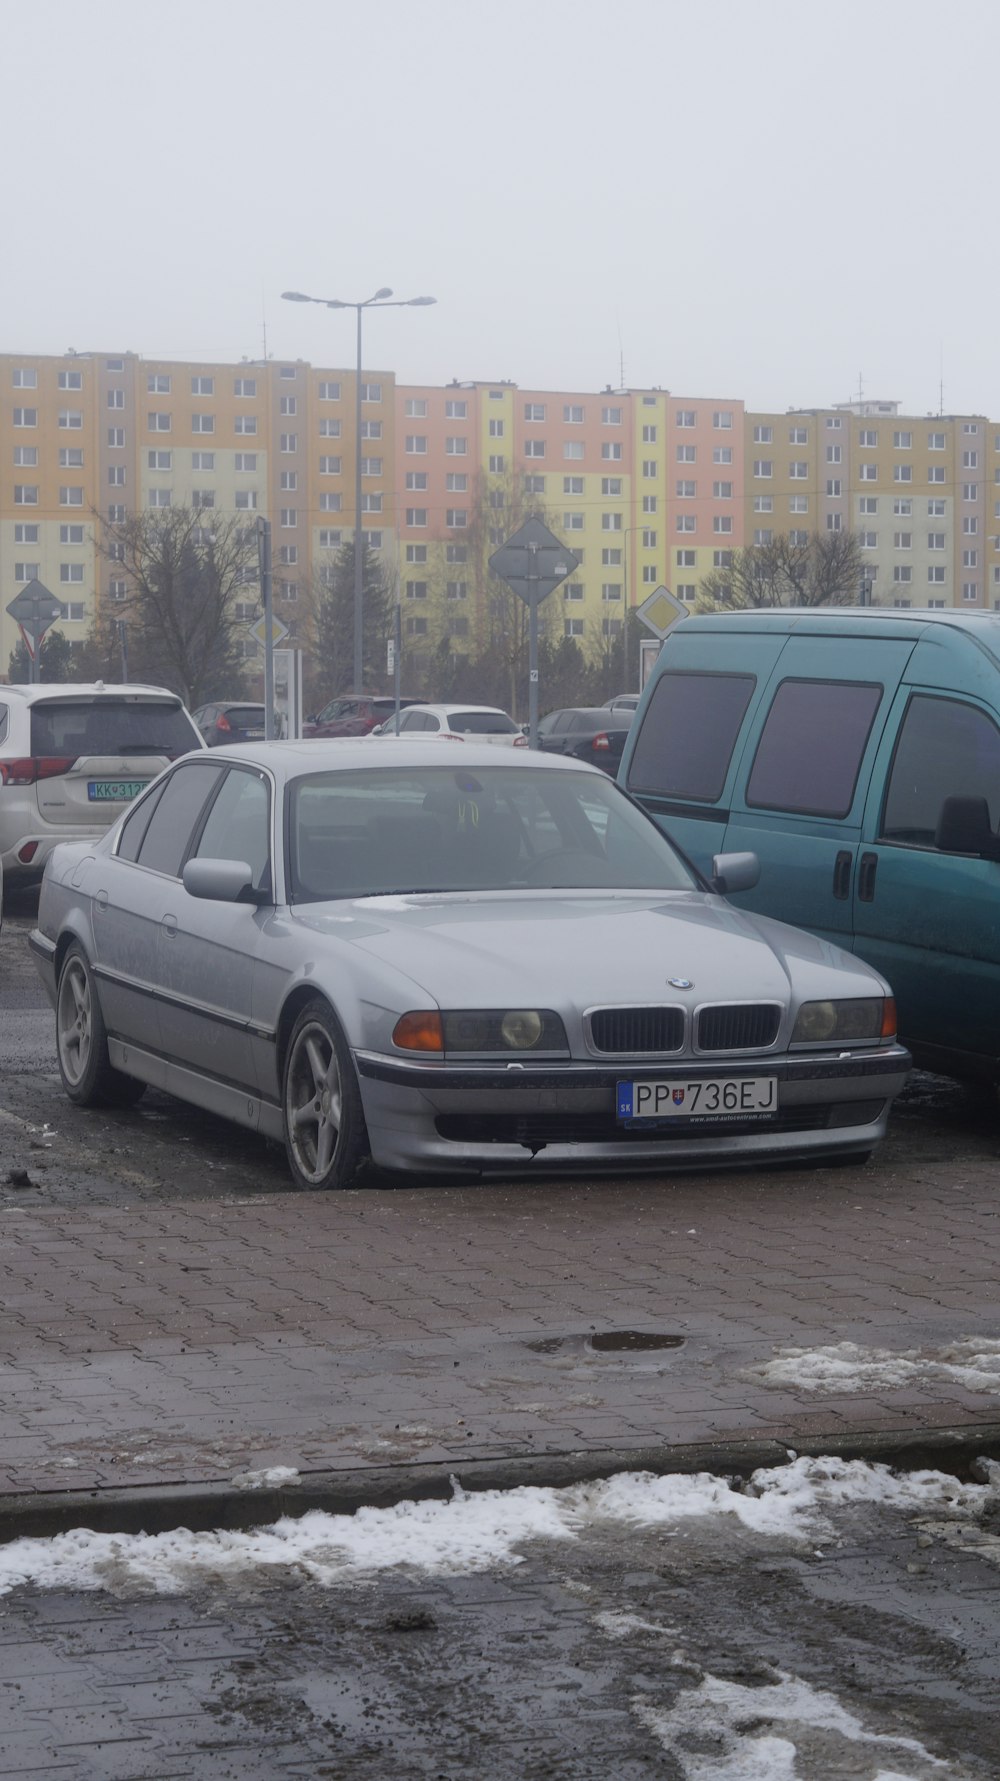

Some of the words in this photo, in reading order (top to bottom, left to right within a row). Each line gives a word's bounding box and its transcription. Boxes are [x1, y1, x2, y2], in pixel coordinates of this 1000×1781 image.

[96, 784, 112, 796] KK
[636, 1084, 670, 1114] PP
[687, 1080, 773, 1111] 736EJ
[620, 1103, 631, 1112] SK
